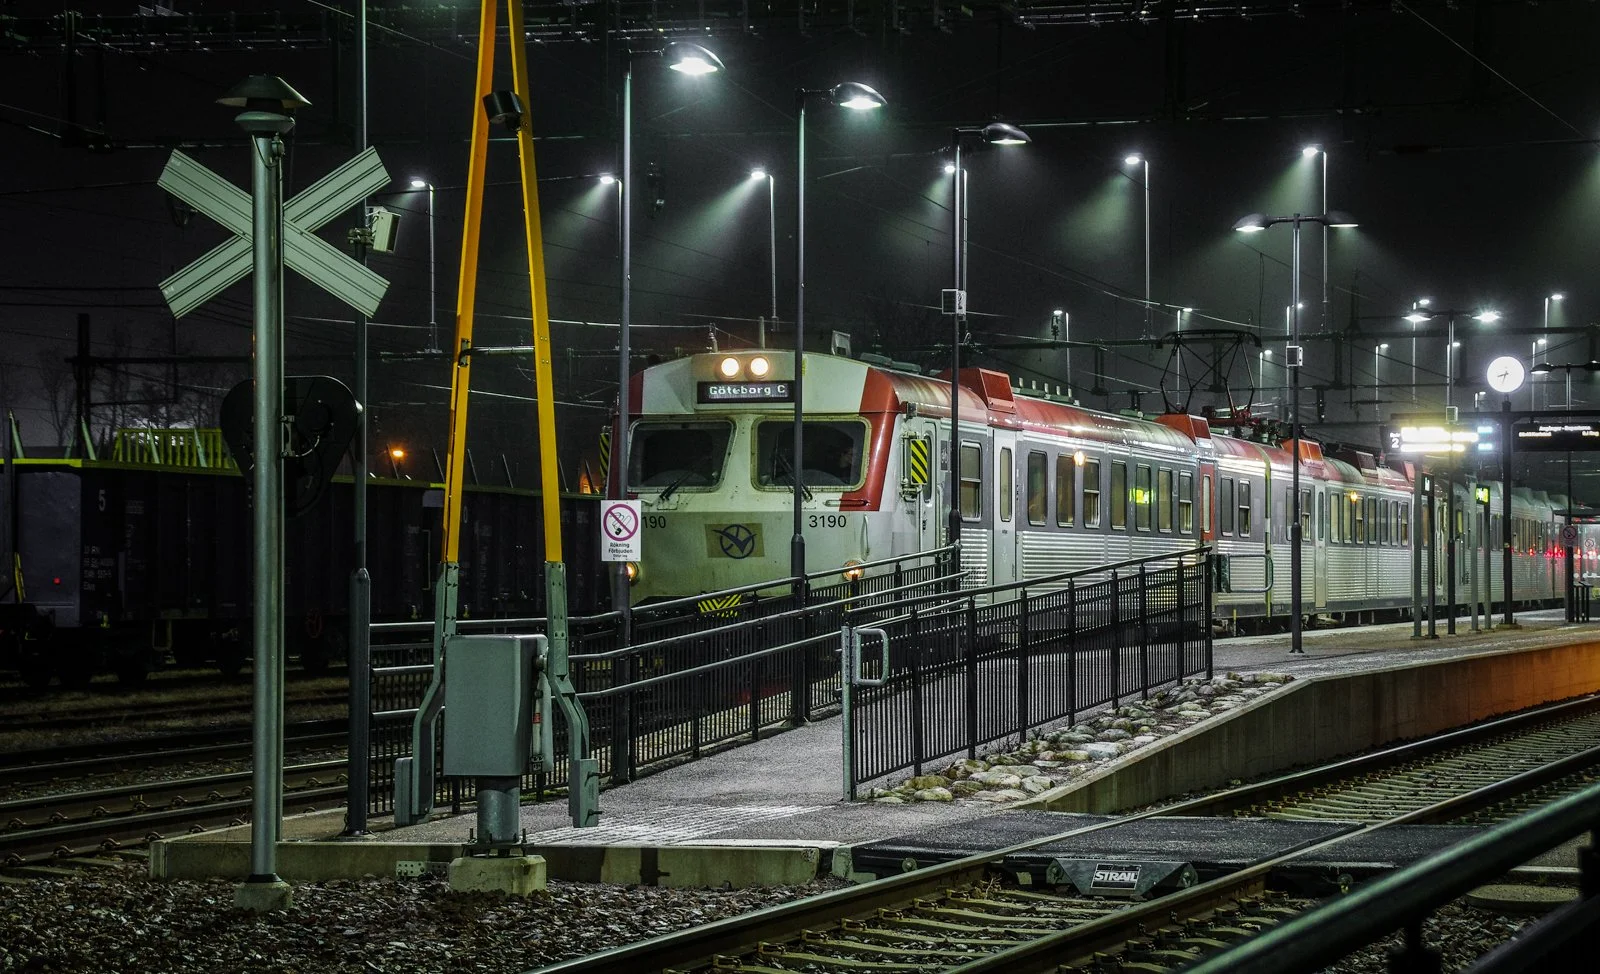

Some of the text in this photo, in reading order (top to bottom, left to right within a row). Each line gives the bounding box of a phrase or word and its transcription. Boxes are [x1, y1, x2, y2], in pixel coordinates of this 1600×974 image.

[708, 384, 786, 396] Göteborg C
[1391, 437, 1400, 449] 2
[98, 489, 107, 512] 5
[641, 515, 667, 529] 190
[808, 514, 847, 528] 3190
[1094, 871, 1139, 881] STRAIL
